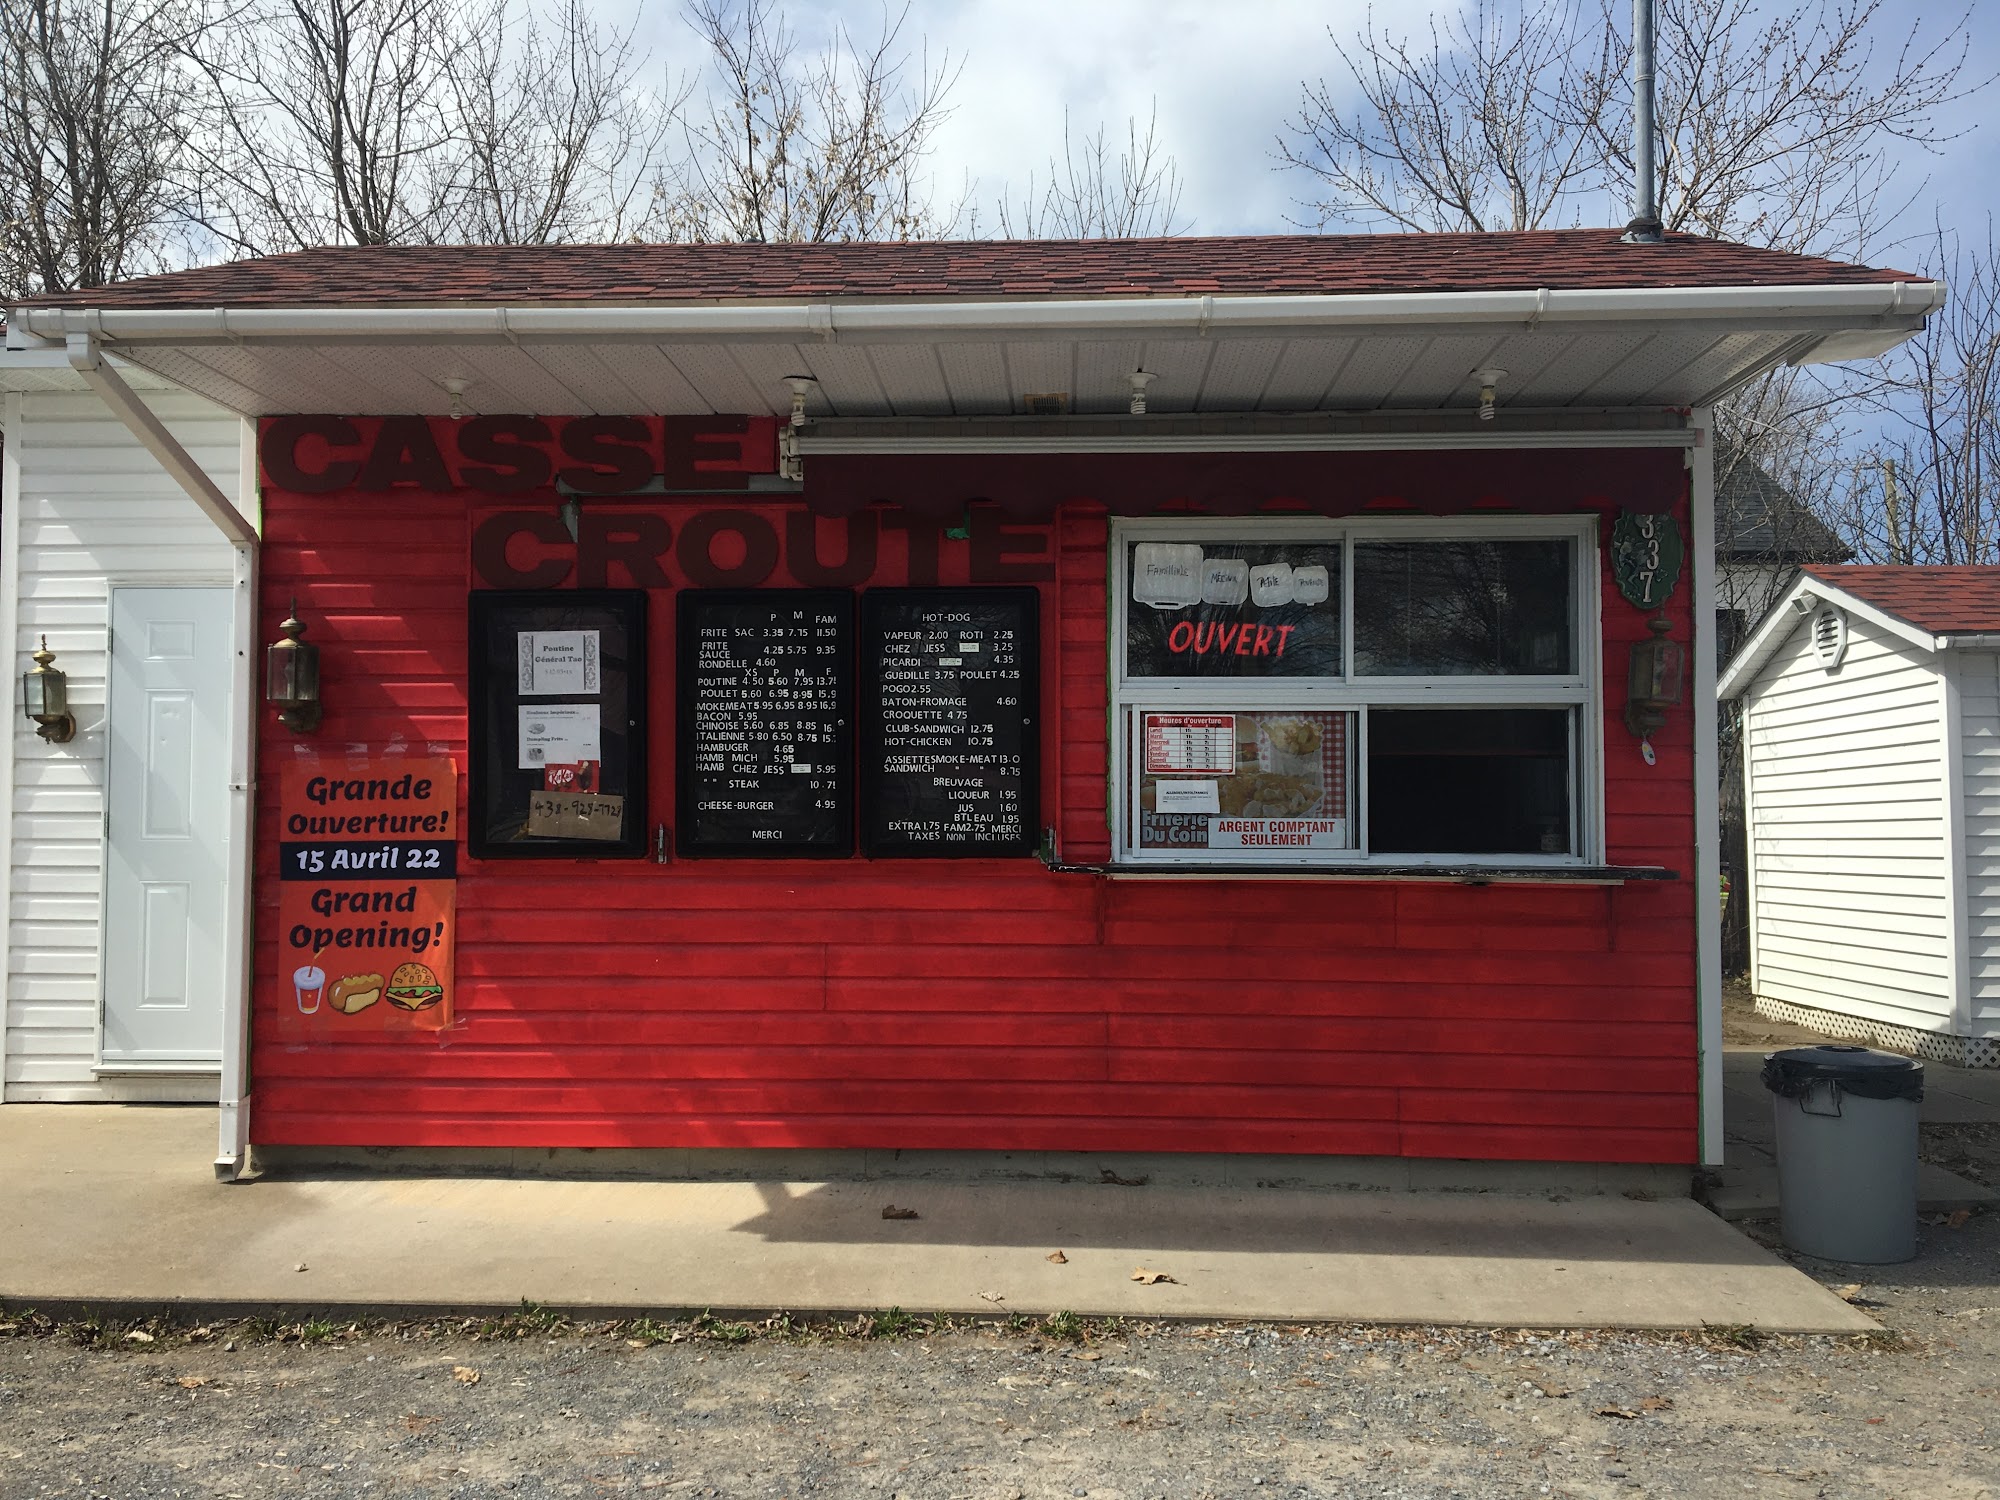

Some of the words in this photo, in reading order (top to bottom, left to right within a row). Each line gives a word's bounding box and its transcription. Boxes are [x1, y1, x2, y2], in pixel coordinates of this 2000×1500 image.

[259, 413, 749, 494] CASSE
[472, 505, 1057, 590] CROUTE
[770, 613, 777, 622] P
[793, 611, 803, 619] M
[815, 615, 837, 624] FAM
[922, 613, 971, 622] HOT-DOG
[701, 628, 727, 637] FRITE
[735, 628, 755, 637] SAC
[763, 629, 784, 637] 3.35
[816, 628, 837, 637] 11.50
[884, 631, 922, 640] VAPEUR
[928, 631, 949, 640] 2.00
[960, 631, 983, 639] ROTI
[993, 631, 1013, 639] 2.25
[1168, 620, 1296, 657] OUVERT
[701, 641, 728, 650] FRITE
[763, 646, 784, 655] 4.25
[787, 646, 807, 655] 5.75
[816, 646, 836, 655] 9.35
[885, 645, 910, 653] CHEZ
[924, 644, 946, 653] JESS
[993, 643, 1013, 651] 3.25
[699, 651, 730, 659] SAUCE
[699, 660, 747, 669] RONDELLE
[756, 658, 776, 667] 4.60
[883, 658, 921, 667] PICARDI
[994, 655, 1014, 663] 4.35
[745, 668, 758, 677] XS
[773, 669, 780, 677] P
[795, 669, 805, 677] M
[826, 668, 832, 676] F
[934, 671, 955, 680] 3.75
[960, 671, 997, 679] POULET
[1000, 670, 1020, 679] 4.25
[698, 678, 737, 686] POUTINE
[768, 677, 788, 686] 5.60
[700, 690, 738, 698] POULET
[741, 690, 762, 699] 5.60
[769, 689, 789, 698] 6.95
[793, 690, 813, 699] 8.95
[882, 685, 910, 693] POGO
[911, 685, 931, 693] 2.55
[695, 702, 752, 711] MOKEMEAT
[753, 702, 773, 710] 5.95
[797, 702, 817, 710] 8.95
[881, 697, 967, 706] BATON-FROMAGE
[996, 697, 1017, 706] 4.60
[696, 712, 731, 721] BACON
[738, 712, 758, 721] 5.95
[883, 710, 942, 719] CROQUETTE
[696, 721, 739, 730] CHINOISE
[743, 721, 764, 730] 5.60
[769, 721, 789, 730] 6.85
[796, 721, 817, 730] 8.85
[885, 724, 965, 734] CLUB-SANDWICH
[970, 724, 994, 733] 12.75
[696, 732, 745, 741] ITALIENNE
[772, 732, 792, 741] 6.50
[797, 733, 818, 742] 8.75
[822, 734, 837, 743] 15.
[884, 737, 952, 746] HOT-CHICKEN
[968, 737, 994, 746] 10.75
[696, 743, 749, 752] HAMBUGER
[773, 744, 794, 753] 4.65
[695, 754, 724, 762] HAMB
[731, 754, 758, 762] MICH
[773, 754, 794, 763] 5.95
[885, 755, 931, 764] ASSIETTE
[931, 755, 997, 763] SMOKE-MEAT
[695, 763, 725, 771] HAMB
[732, 765, 758, 773] CHEZ
[763, 765, 785, 775] JESS
[816, 765, 836, 773] 5.95
[883, 764, 935, 773] SANDWICH
[728, 780, 759, 788] STEAK
[933, 777, 984, 787] BREUVAGE
[306, 774, 432, 805] Grande
[948, 791, 990, 800] LIQUEUR
[1000, 790, 1017, 799] 1.95
[697, 801, 774, 810] CHEESE-BURGER
[815, 800, 836, 809] 4.95
[957, 804, 974, 812] JUS
[1000, 803, 1017, 812] 1.60
[287, 810, 449, 835] Ouverture!
[954, 814, 973, 822] BTL
[974, 814, 994, 822] EAU
[1002, 815, 1020, 824] 1.95
[888, 821, 921, 830] EXTRA
[923, 822, 940, 831] 1.75
[943, 823, 966, 832] FAM
[965, 823, 986, 832] 2.75
[991, 824, 1022, 833] MERCI
[1219, 821, 1265, 833] ARGENT
[1269, 821, 1335, 833] COMPTANT
[752, 831, 782, 839] MERCI
[908, 832, 941, 841] TAXES
[1142, 826, 1165, 842] Du
[1168, 825, 1208, 843] Coin
[1241, 833, 1312, 846] SEULEMENT
[296, 849, 325, 873] 15
[331, 846, 399, 871] Avril
[405, 848, 441, 869] 22
[311, 886, 417, 918] Grand
[289, 921, 444, 954] Opening!
